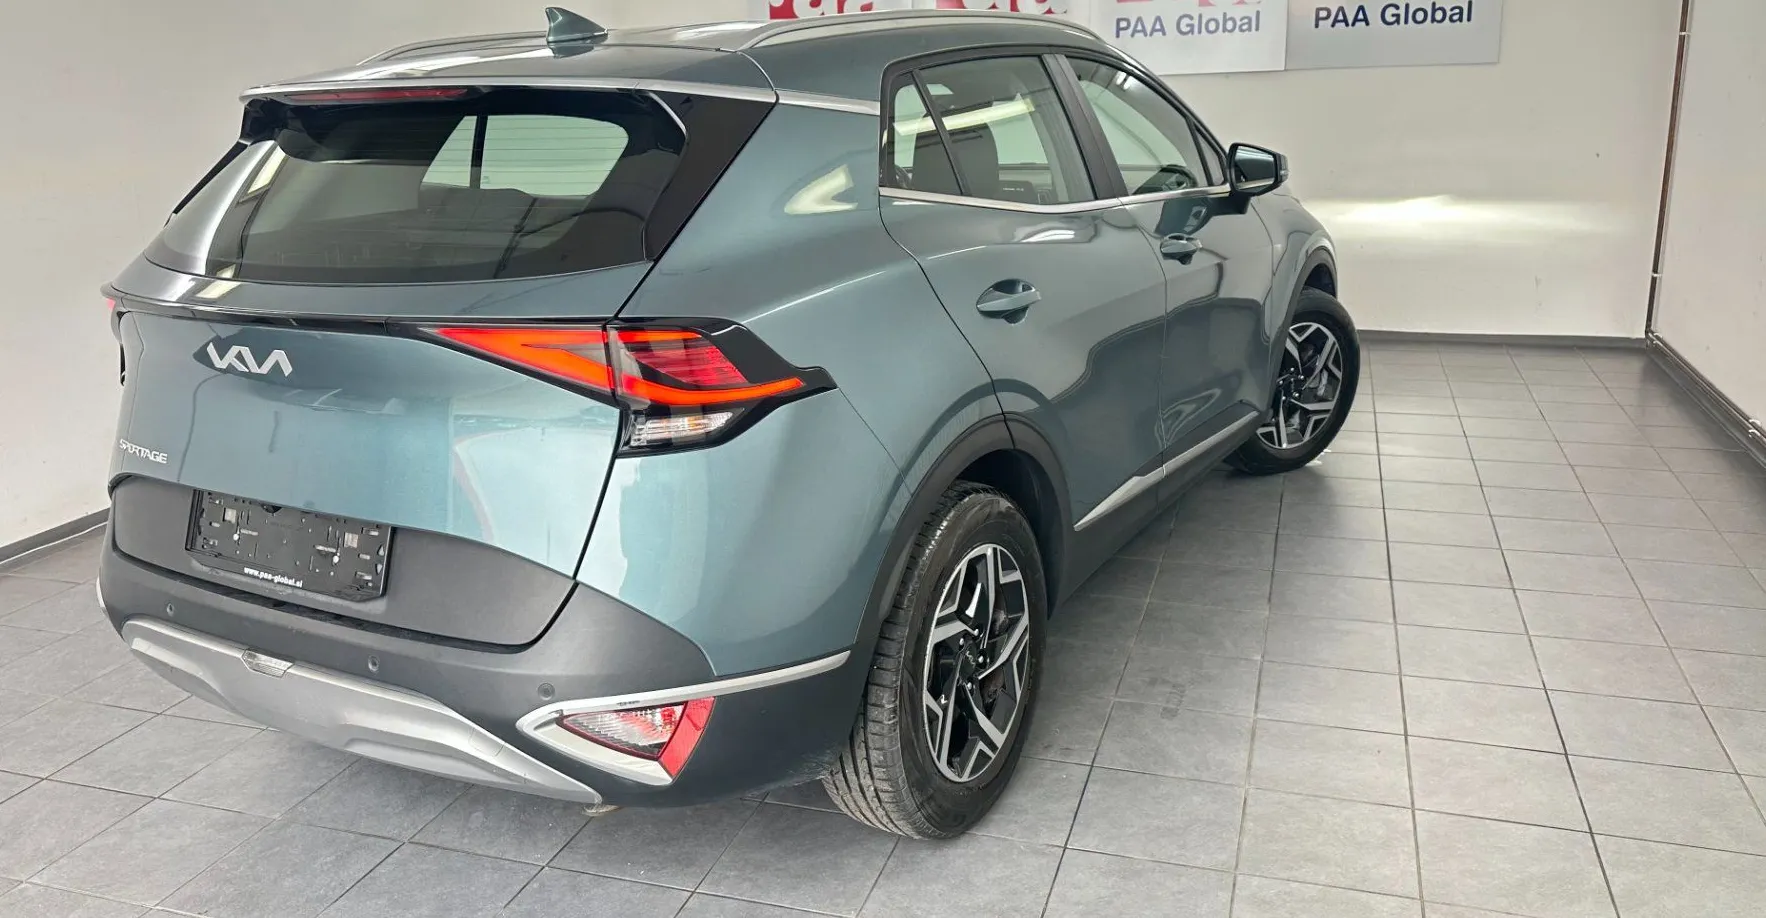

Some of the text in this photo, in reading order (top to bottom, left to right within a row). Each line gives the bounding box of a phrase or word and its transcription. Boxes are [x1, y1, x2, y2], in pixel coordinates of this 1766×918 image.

[1115, 10, 1261, 39] PAA Global
[1314, 0, 1473, 29] PAA Global
[206, 341, 293, 377] KIA
